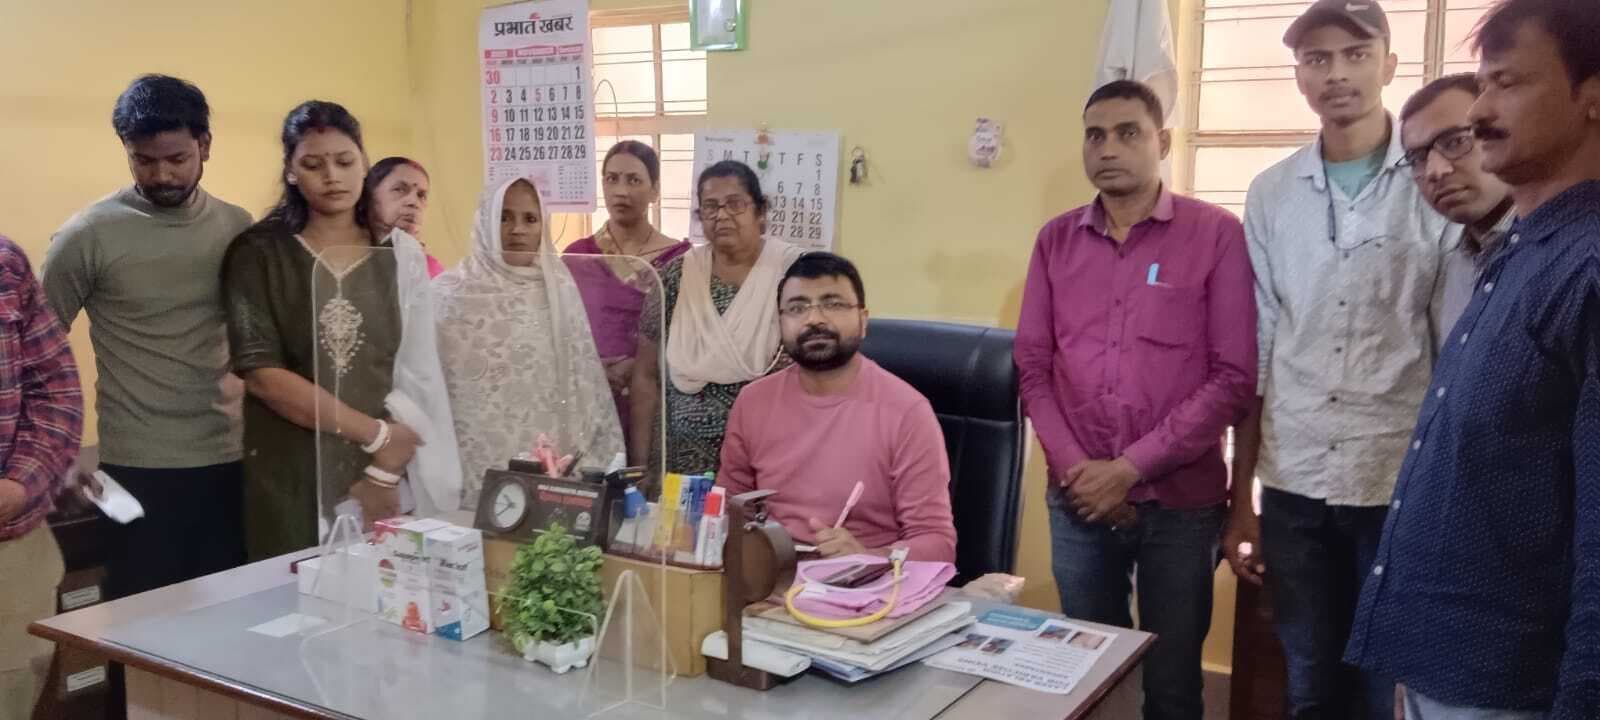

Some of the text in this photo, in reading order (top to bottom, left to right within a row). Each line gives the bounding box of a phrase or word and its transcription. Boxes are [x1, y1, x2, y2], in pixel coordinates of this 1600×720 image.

[494, 16, 574, 36] प्रभात खबर
[486, 66, 581, 85] 30 1
[490, 85, 582, 104] 2 3 4 5 6 7 8
[491, 105, 585, 123] 9 10 11 12 13 14 15
[490, 125, 585, 142] 16 17 18 19 20 21 22
[490, 144, 586, 161] 23 24 25 26 27 28 29
[723, 150, 733, 161] M
[743, 150, 751, 162] T
[779, 152, 786, 165] T
[797, 153, 805, 166] F
[815, 153, 823, 167] S
[815, 169, 821, 180] 1
[777, 181, 821, 195] 6 7 8
[773, 196, 823, 210] 13 14 15
[772, 210, 822, 225] 20 21 22
[770, 224, 822, 239] 27 28 29
